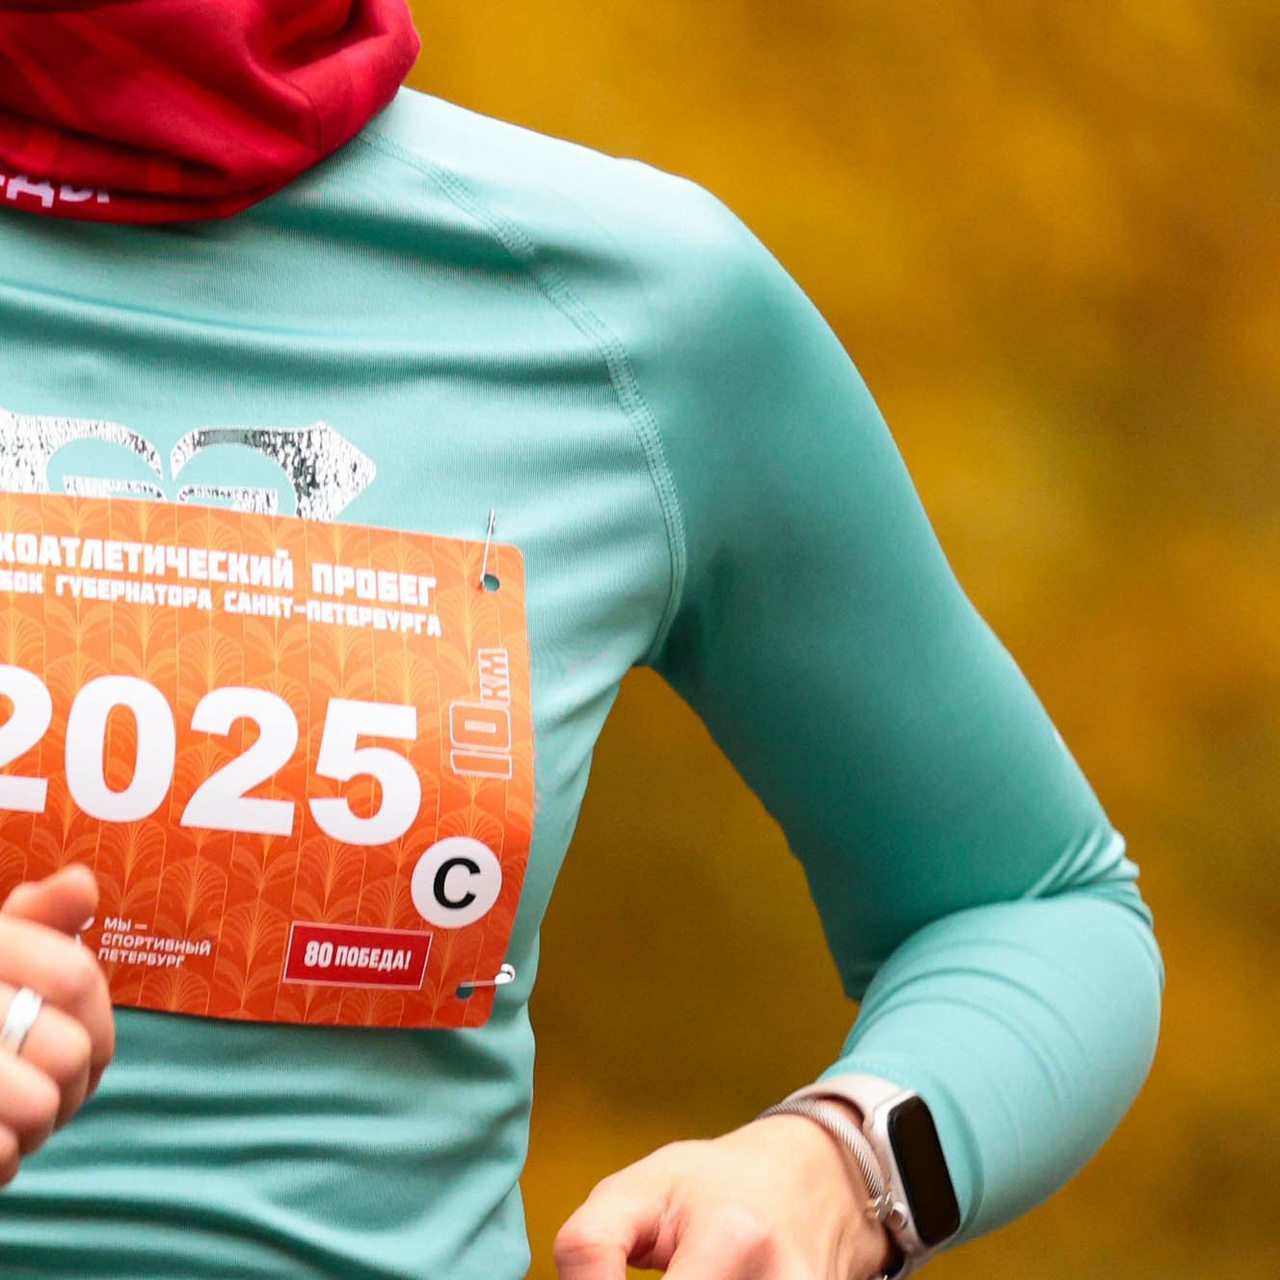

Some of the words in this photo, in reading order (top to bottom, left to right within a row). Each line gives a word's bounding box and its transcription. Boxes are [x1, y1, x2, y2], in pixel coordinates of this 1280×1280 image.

[311, 562, 437, 607] ПРОБЕГ
[55, 574, 213, 610] ГУБЕРНАТОРА
[223, 590, 442, 637] САНКТ-ПЕТЕРБУРГА
[103, 917, 131, 933] МЫ
[98, 947, 185, 969] ПЕТЕРБУРГ
[101, 932, 211, 957] СПОРТИВНЫЙ
[304, 940, 333, 968] 80
[335, 945, 412, 972] ПОБЕДА!
